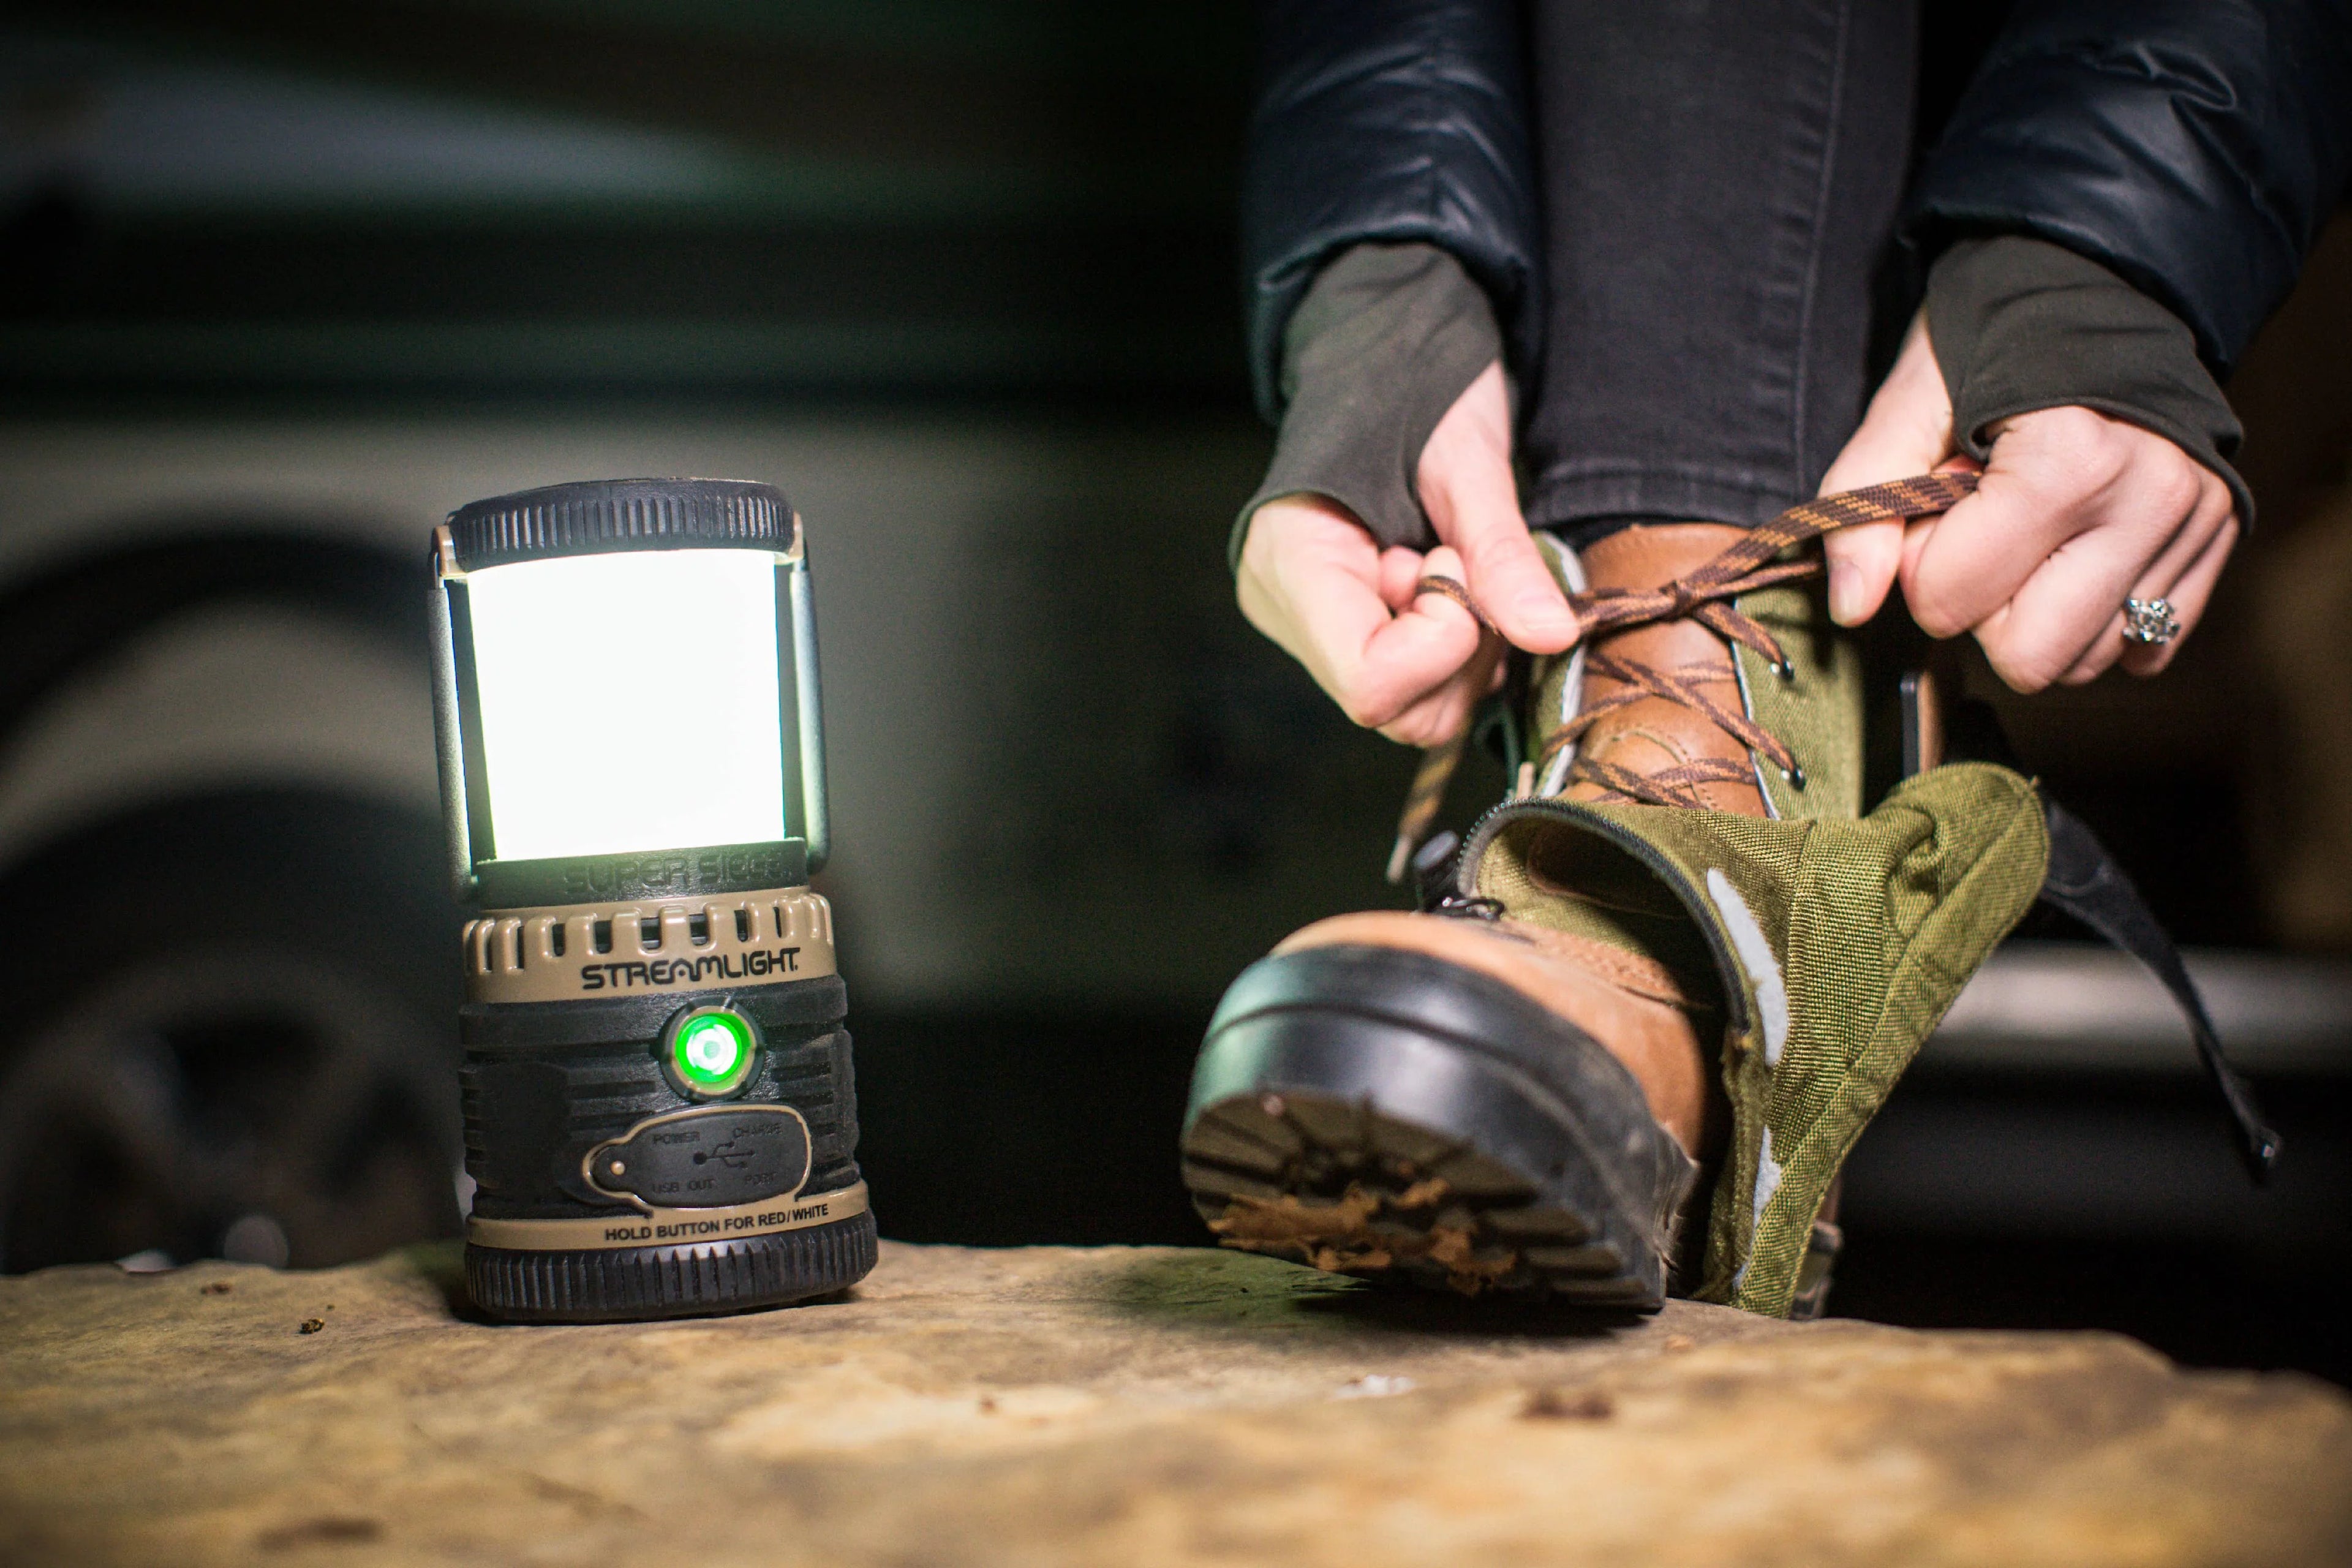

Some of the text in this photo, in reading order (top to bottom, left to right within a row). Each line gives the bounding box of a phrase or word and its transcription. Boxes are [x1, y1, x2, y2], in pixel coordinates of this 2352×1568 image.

[581, 947, 801, 990] STREAMLIGHT
[606, 1225, 652, 1240] HOLD
[657, 1219, 720, 1237] BUTTON
[724, 1215, 754, 1231] FOR
